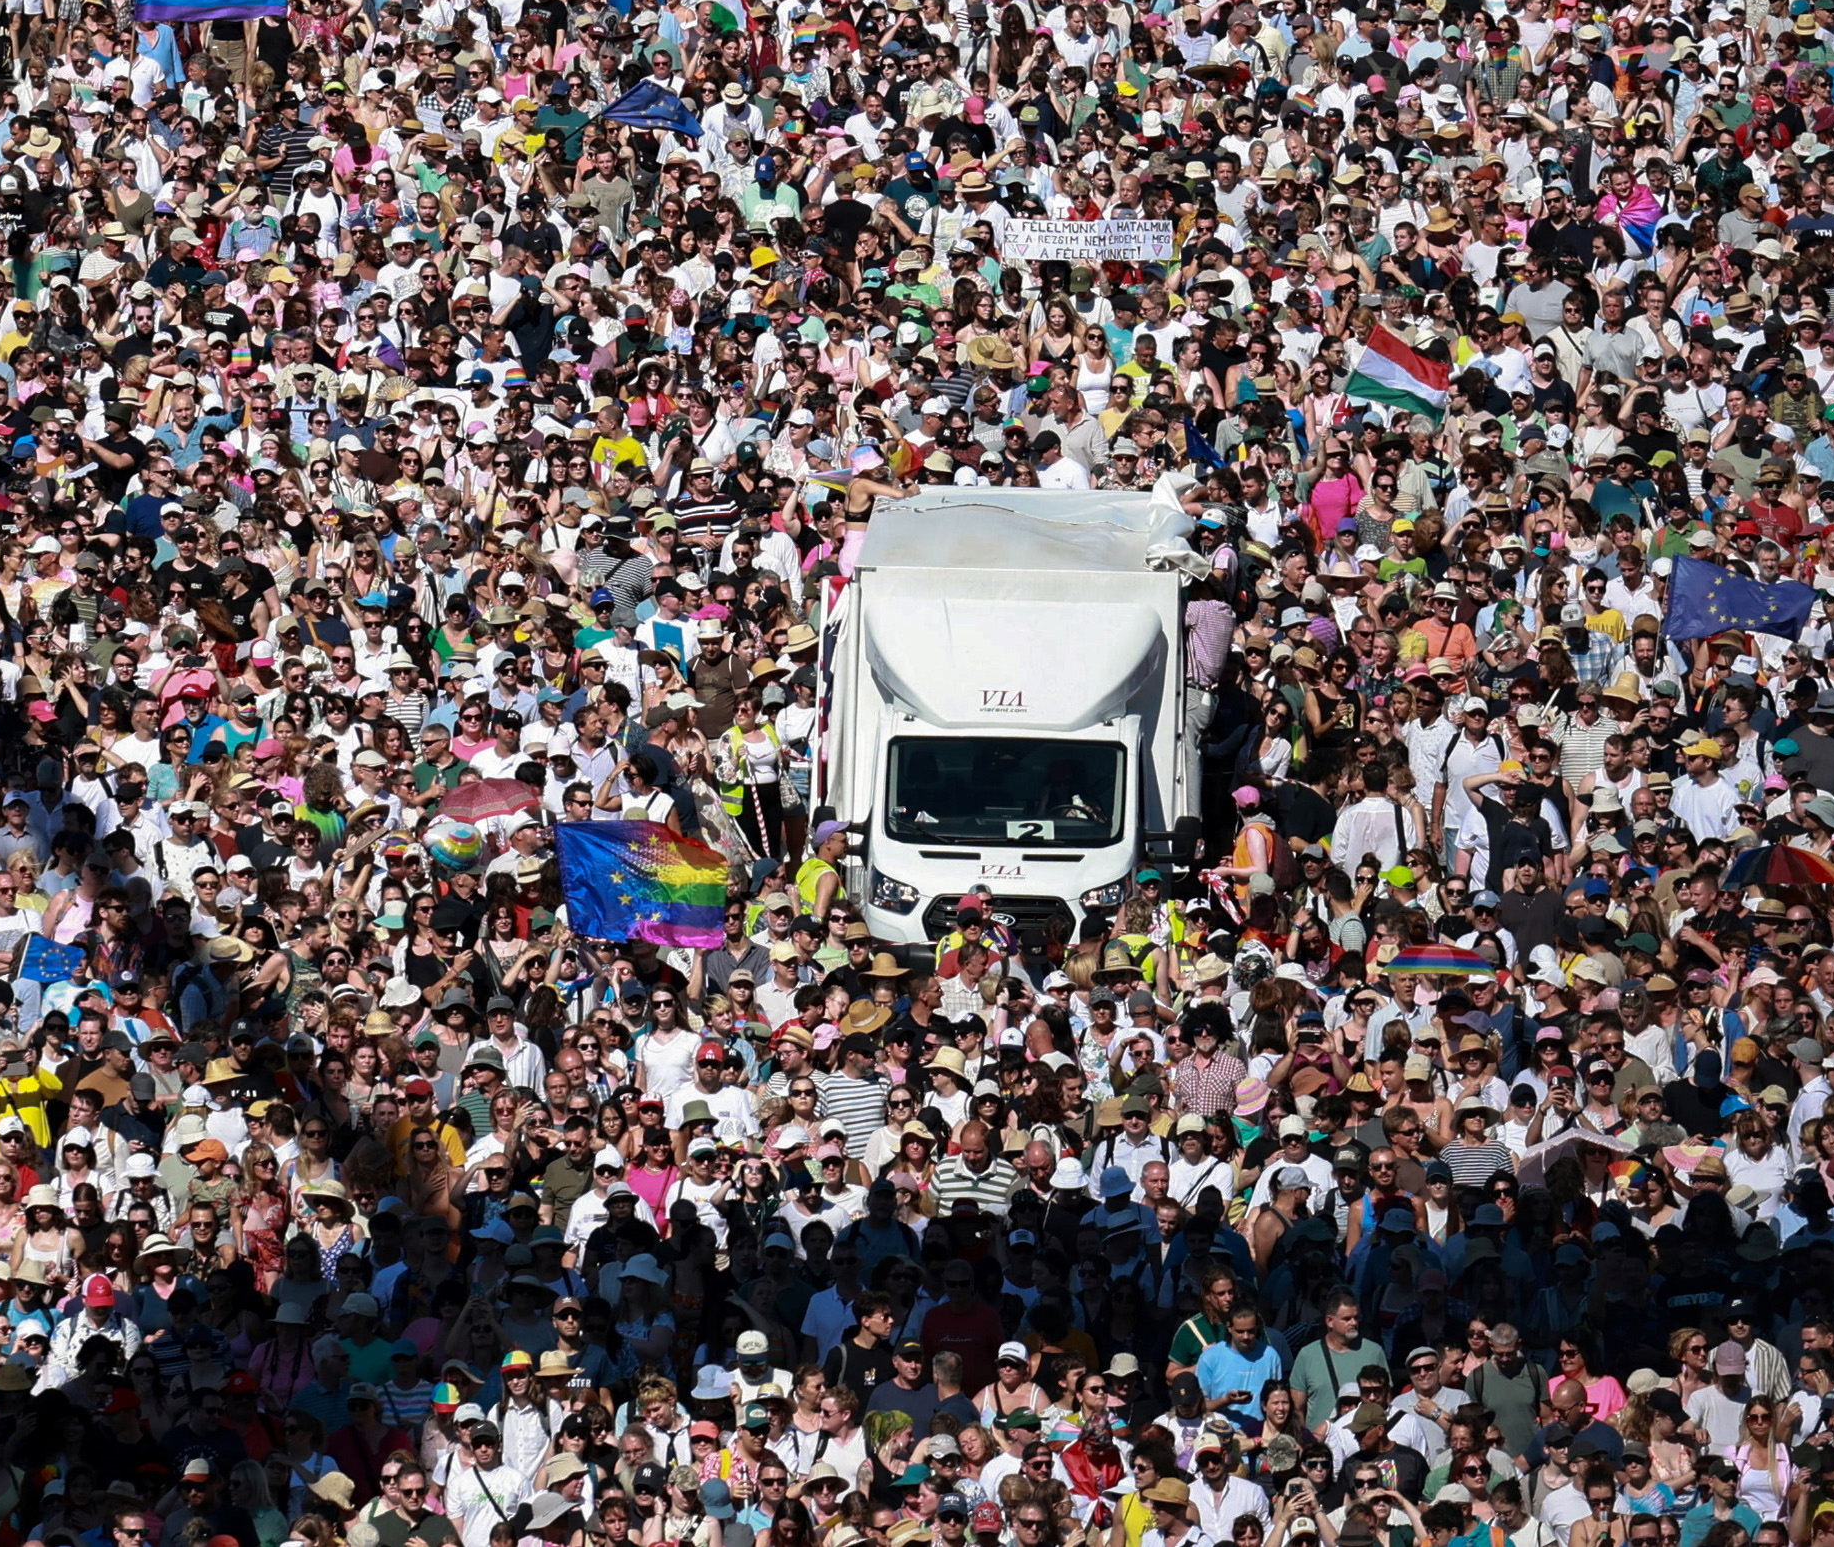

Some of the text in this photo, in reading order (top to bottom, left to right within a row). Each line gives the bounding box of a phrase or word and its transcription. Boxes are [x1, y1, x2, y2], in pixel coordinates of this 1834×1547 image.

[1104, 224, 1112, 234] A
[1117, 222, 1171, 233] HATALMUK
[1025, 235, 1033, 244] A
[1038, 235, 1079, 245] REZSIM
[1084, 235, 1106, 247] NEM
[1152, 234, 1170, 244] MEG
[1039, 248, 1050, 259] A
[1018, 822, 1044, 840] 2
